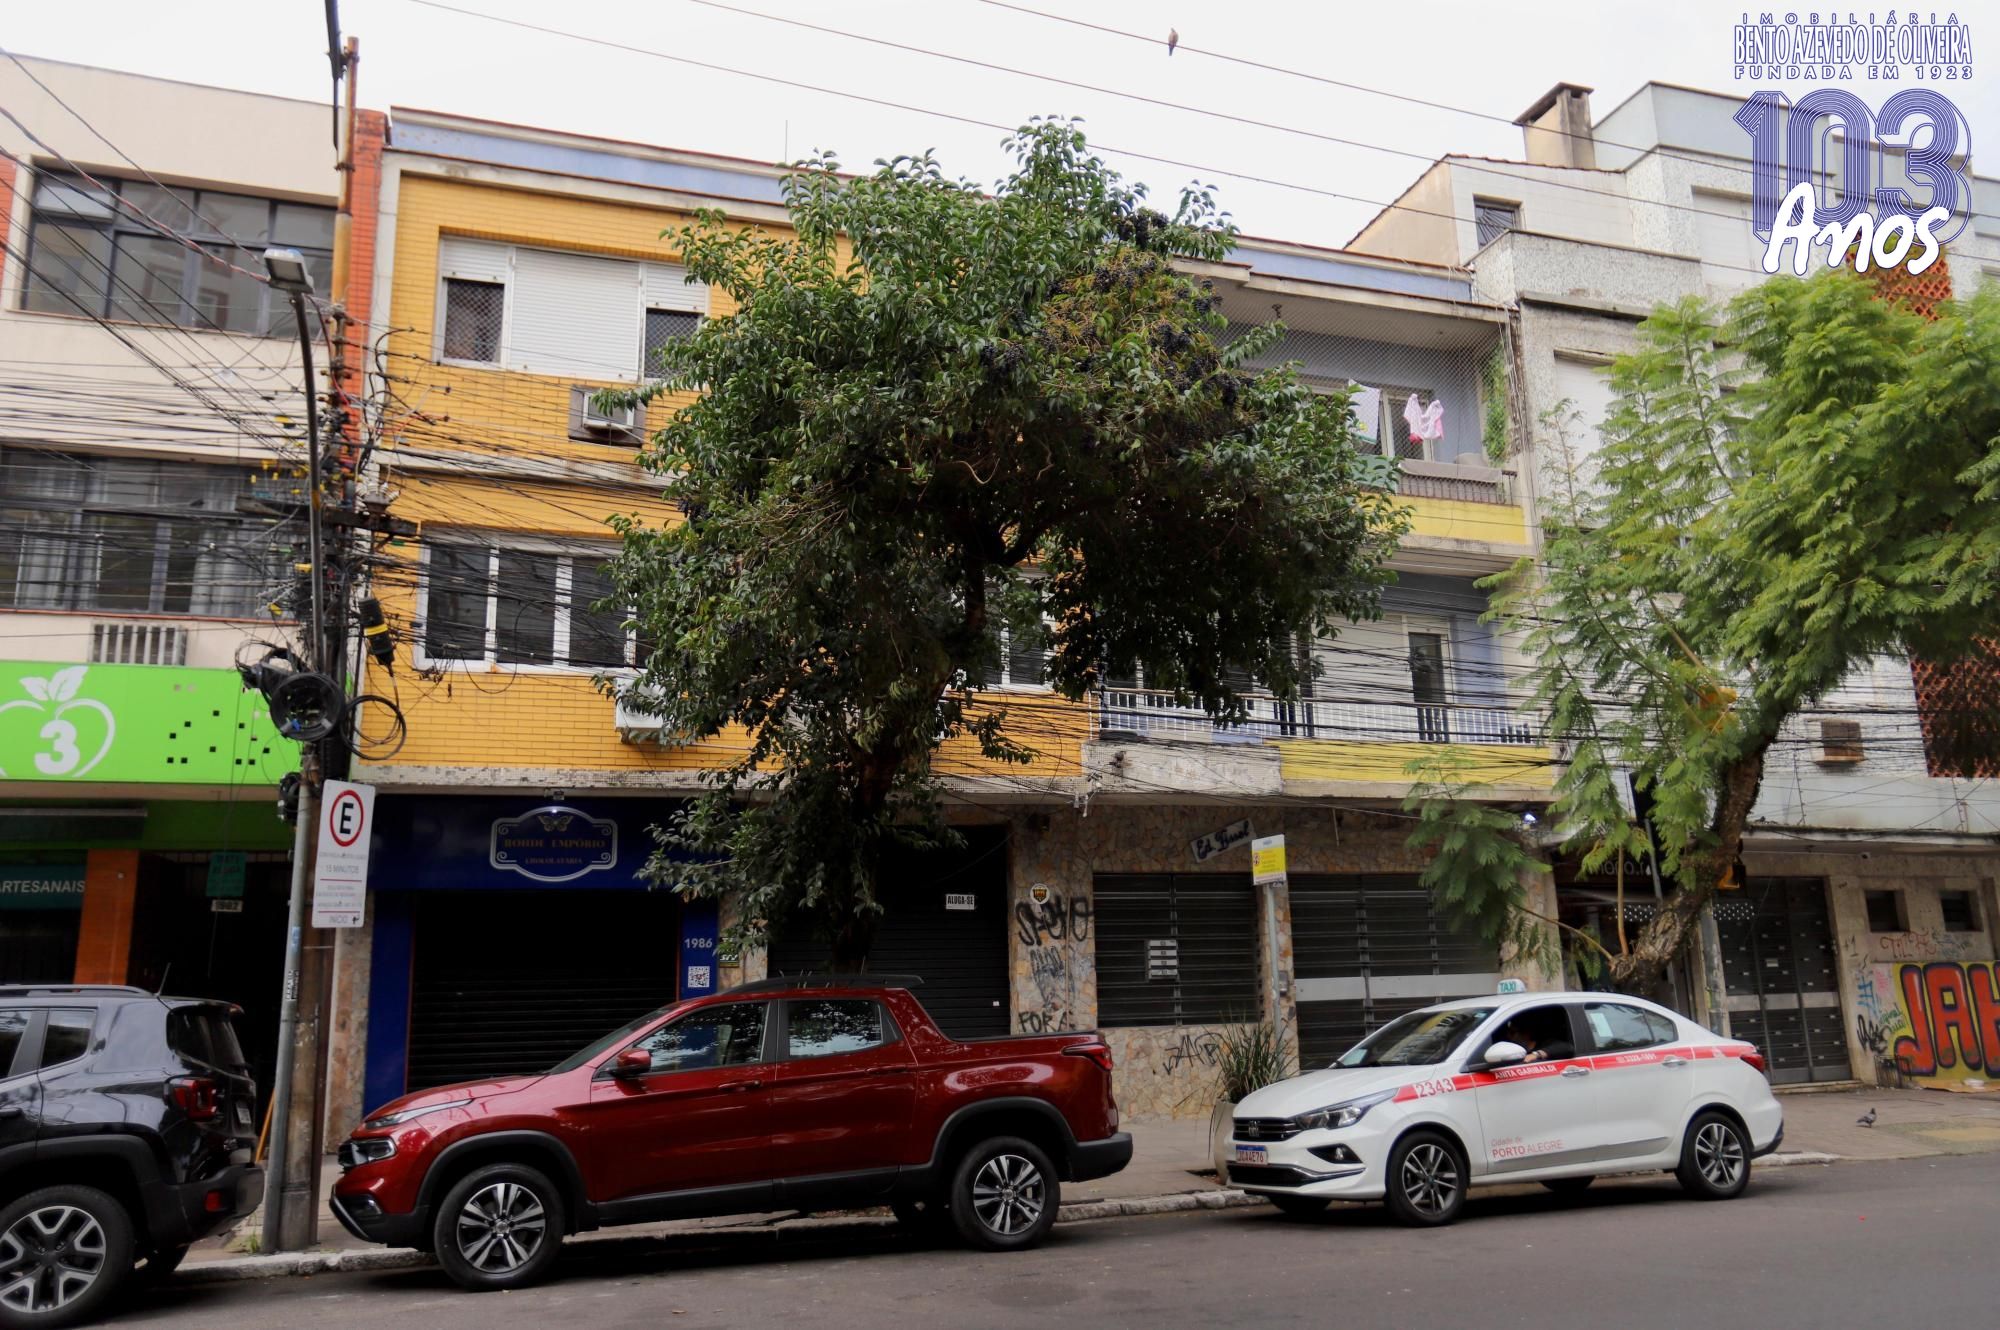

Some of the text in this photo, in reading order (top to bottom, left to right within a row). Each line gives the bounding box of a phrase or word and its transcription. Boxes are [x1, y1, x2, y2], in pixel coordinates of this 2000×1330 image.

[34, 719, 80, 775] 3
[340, 802, 354, 834] E
[0, 880, 86, 893] RTESANAIS
[947, 895, 974, 905] ALUGA-SE
[684, 938, 713, 948] 1986
[1500, 982, 1517, 992] TAXI
[1495, 1064, 1557, 1080] ANITA GARIBALDI
[1416, 1078, 1454, 1098] 2343
[1492, 1138, 1564, 1159] PORTO ALEGRE
